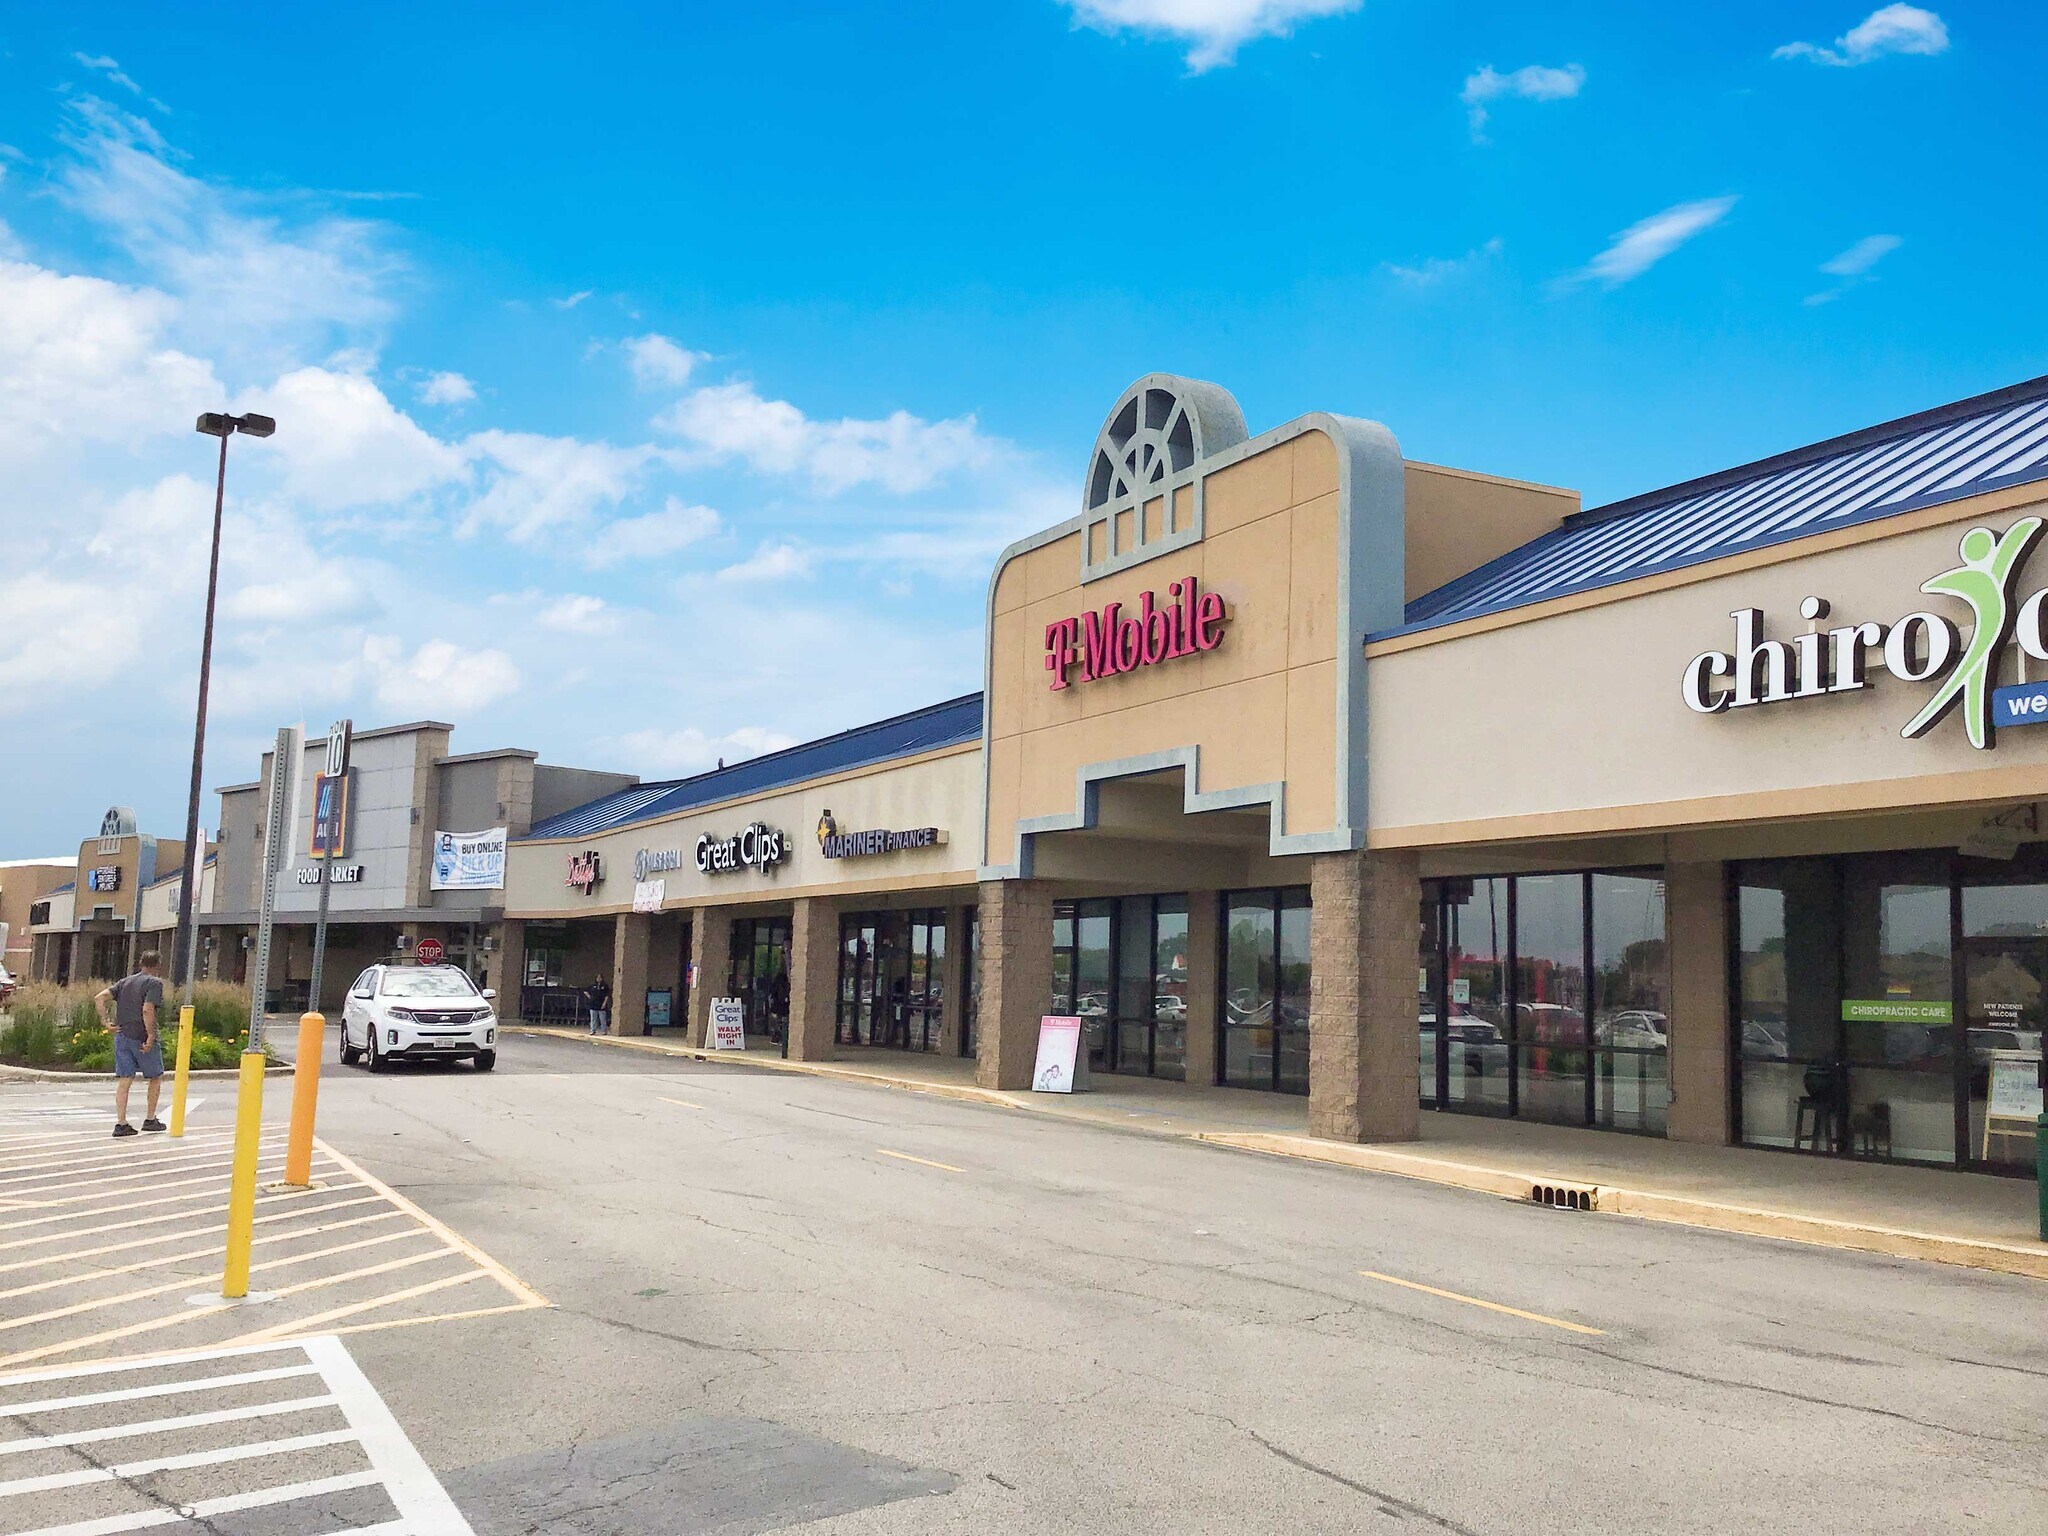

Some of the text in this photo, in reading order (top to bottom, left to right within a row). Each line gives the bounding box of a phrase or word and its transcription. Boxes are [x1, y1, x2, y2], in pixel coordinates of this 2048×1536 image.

[1681, 595, 1955, 714] chiro
[327, 732, 343, 774] 10
[316, 822, 339, 838] ALI
[461, 841, 503, 854] BUY ONLINE
[695, 833, 737, 872] Great
[740, 823, 780, 873] Clips
[824, 828, 932, 859] MARINER FINANCE
[487, 853, 502, 870] UP
[296, 865, 360, 884] FOOD ARKET
[418, 946, 442, 957] STOP
[715, 1005, 742, 1013] Great
[1850, 1005, 1947, 1018] CHIROPRACTIC CARE
[716, 1014, 739, 1023] Clips
